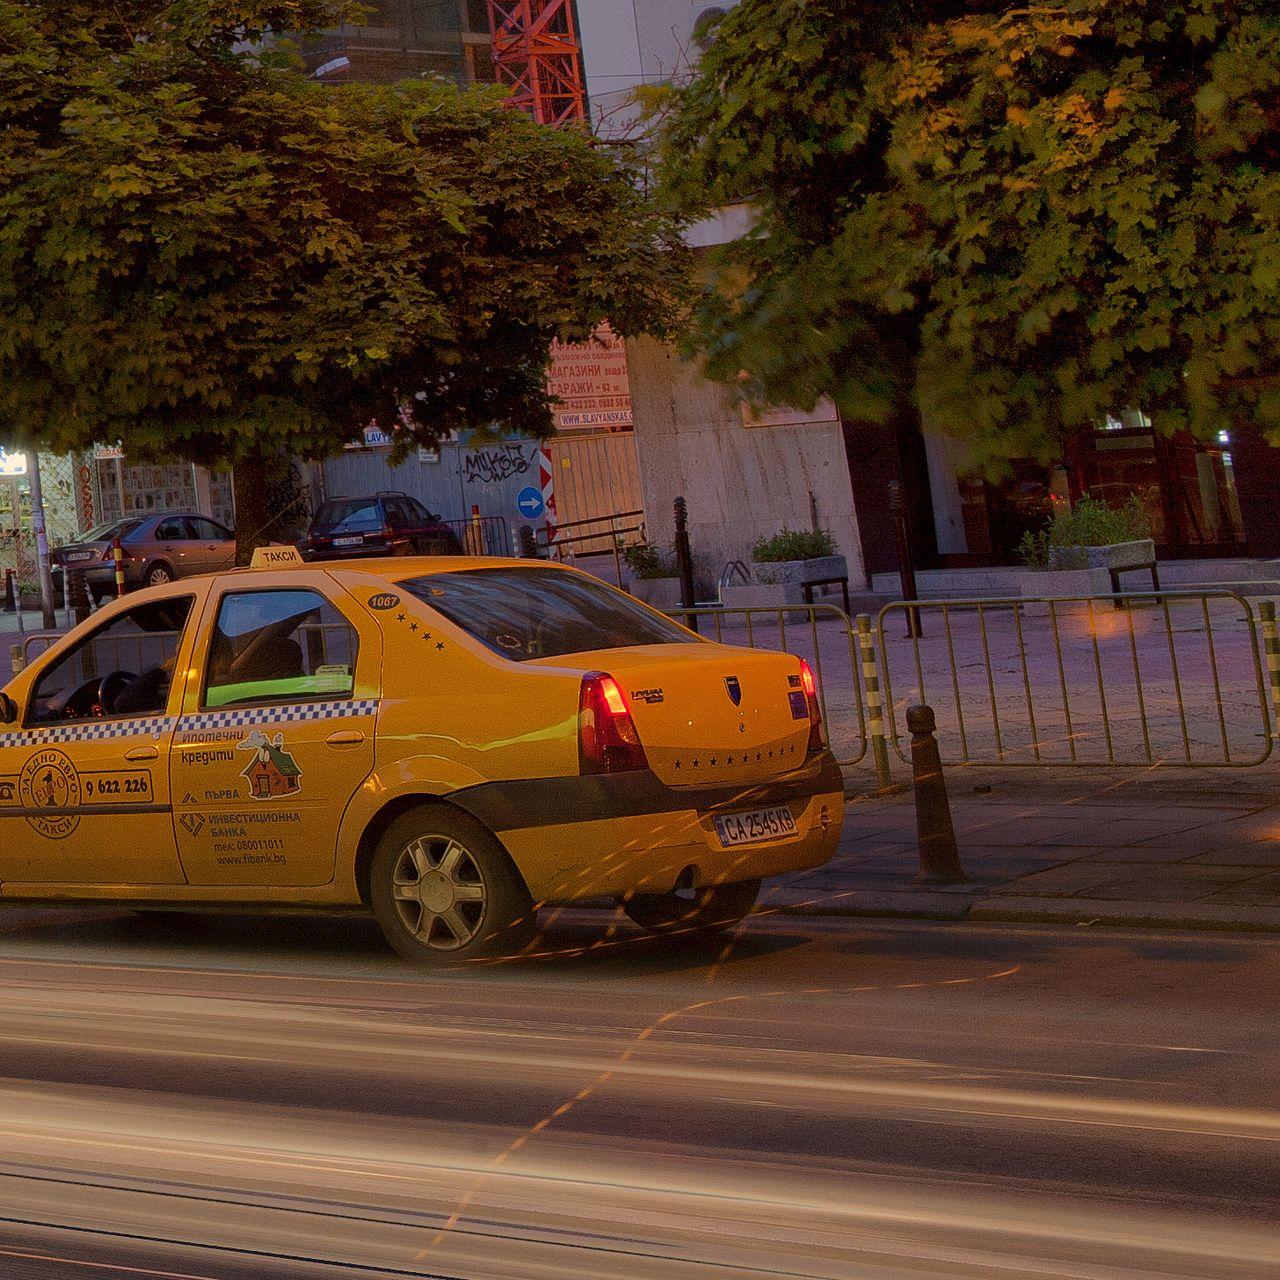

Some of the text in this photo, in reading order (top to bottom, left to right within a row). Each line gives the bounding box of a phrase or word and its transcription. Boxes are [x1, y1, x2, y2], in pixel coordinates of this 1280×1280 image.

[550, 382, 593, 395] ГАРАЖИ
[263, 551, 297, 563] ТАКСИ
[370, 596, 398, 608] 1067
[98, 779, 121, 794] 622
[124, 777, 148, 793] 226
[749, 811, 779, 838] 2545
